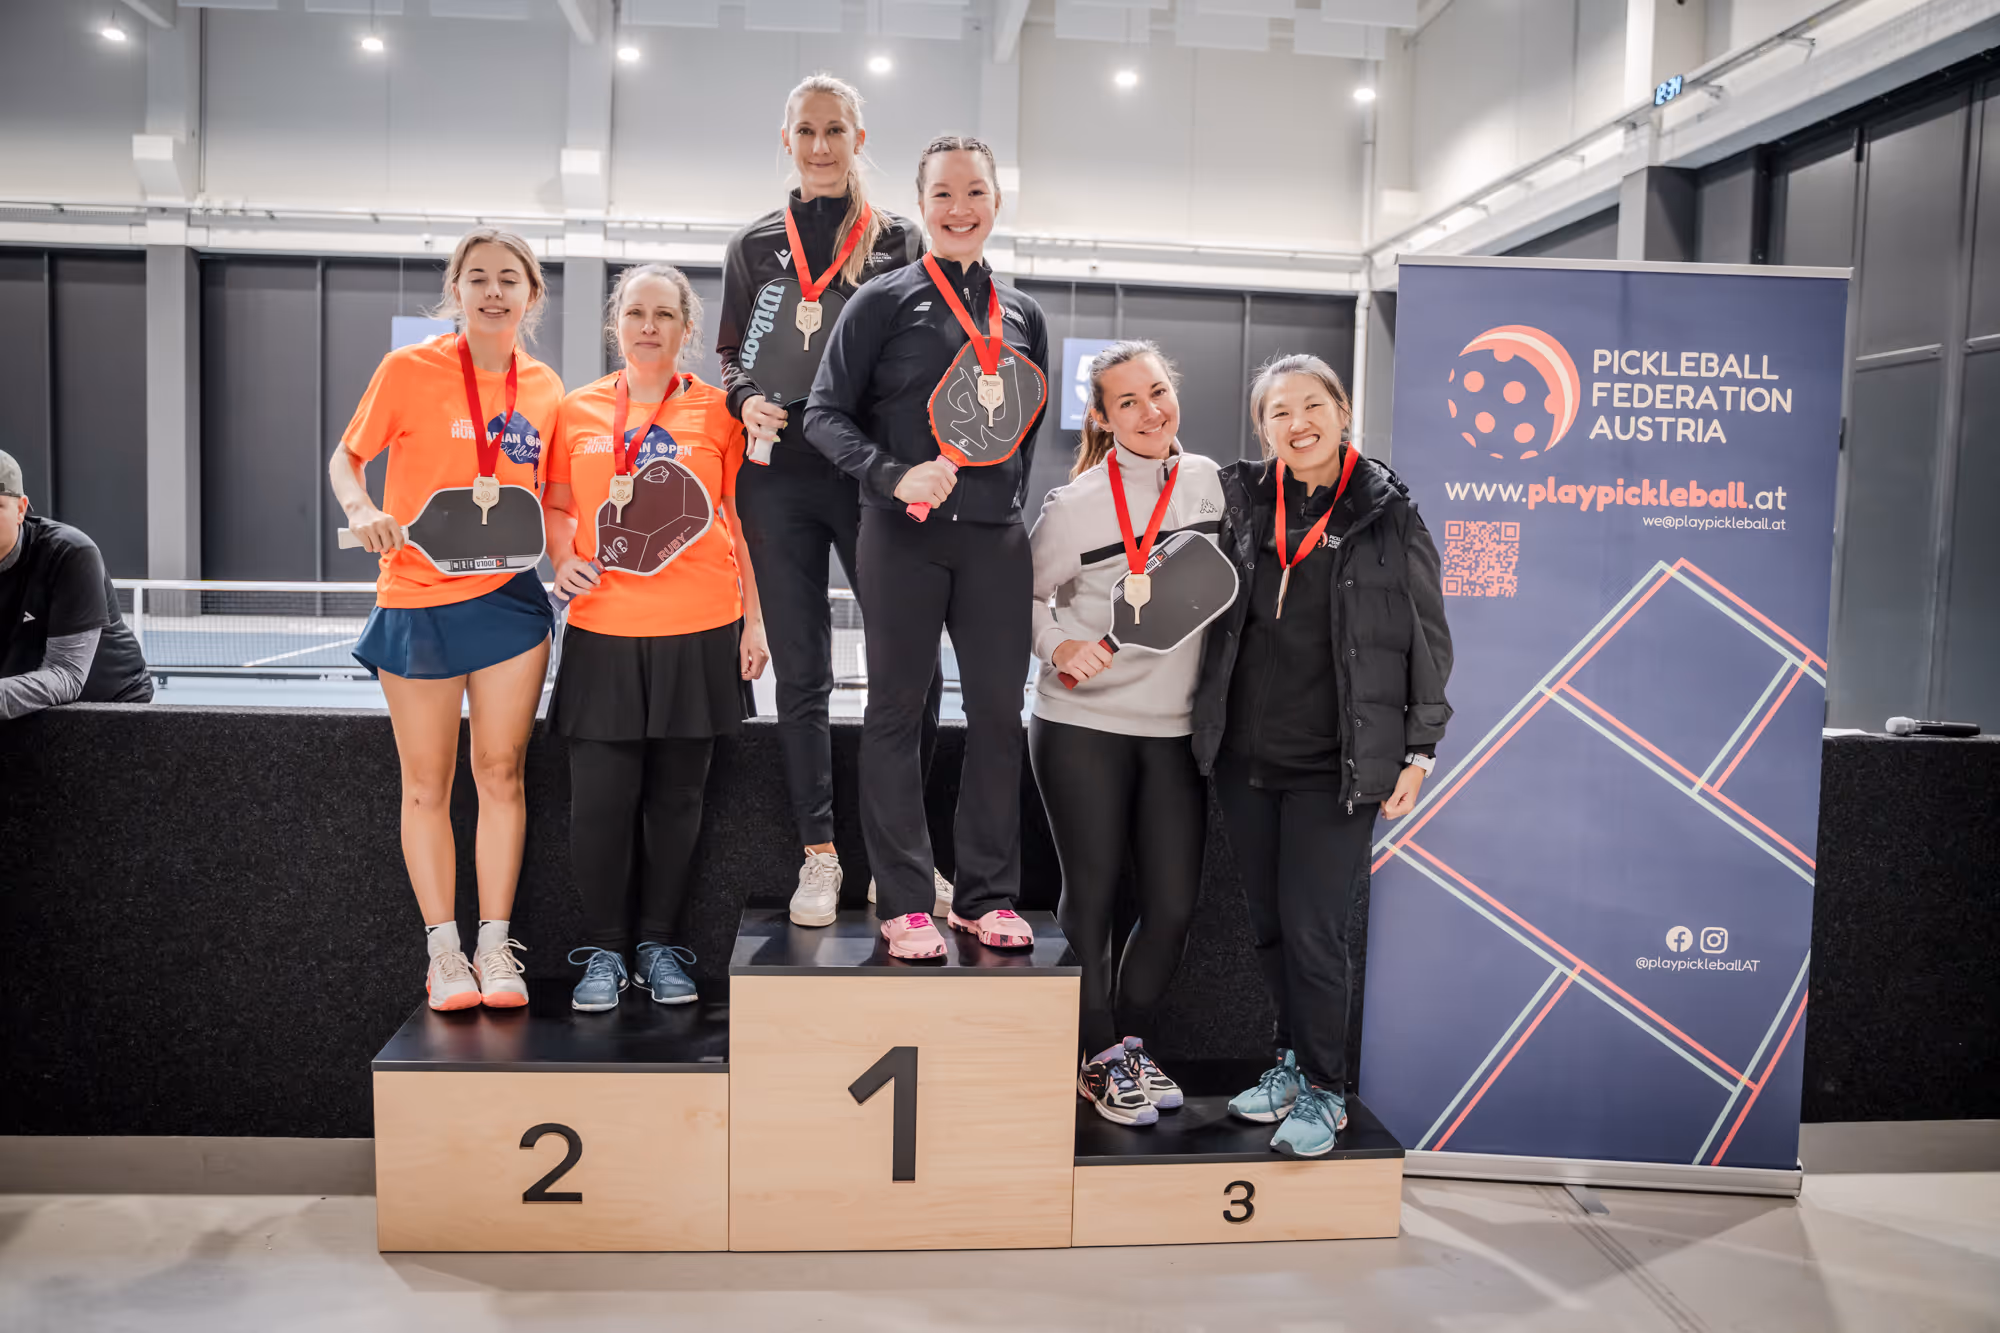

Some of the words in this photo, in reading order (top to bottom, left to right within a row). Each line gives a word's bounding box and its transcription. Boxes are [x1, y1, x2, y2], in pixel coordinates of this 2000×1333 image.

[741, 284, 786, 370] Wilson
[1593, 349, 1779, 380] PICKLEBALL
[1592, 382, 1792, 413] FEDERATION
[1589, 415, 1727, 444] AUSTRIA
[656, 442, 693, 457] OPEN
[1445, 476, 1787, 512] www.playpickleball.at
[1643, 515, 1786, 531] we@playpickleball.at
[656, 532, 687, 562] RUBY
[475, 560, 495, 568] JOOLA
[1635, 956, 1760, 972] @playpickleballAT
[848, 1046, 918, 1183] 1
[519, 1122, 583, 1204] 2
[1222, 1180, 1256, 1223] 3
